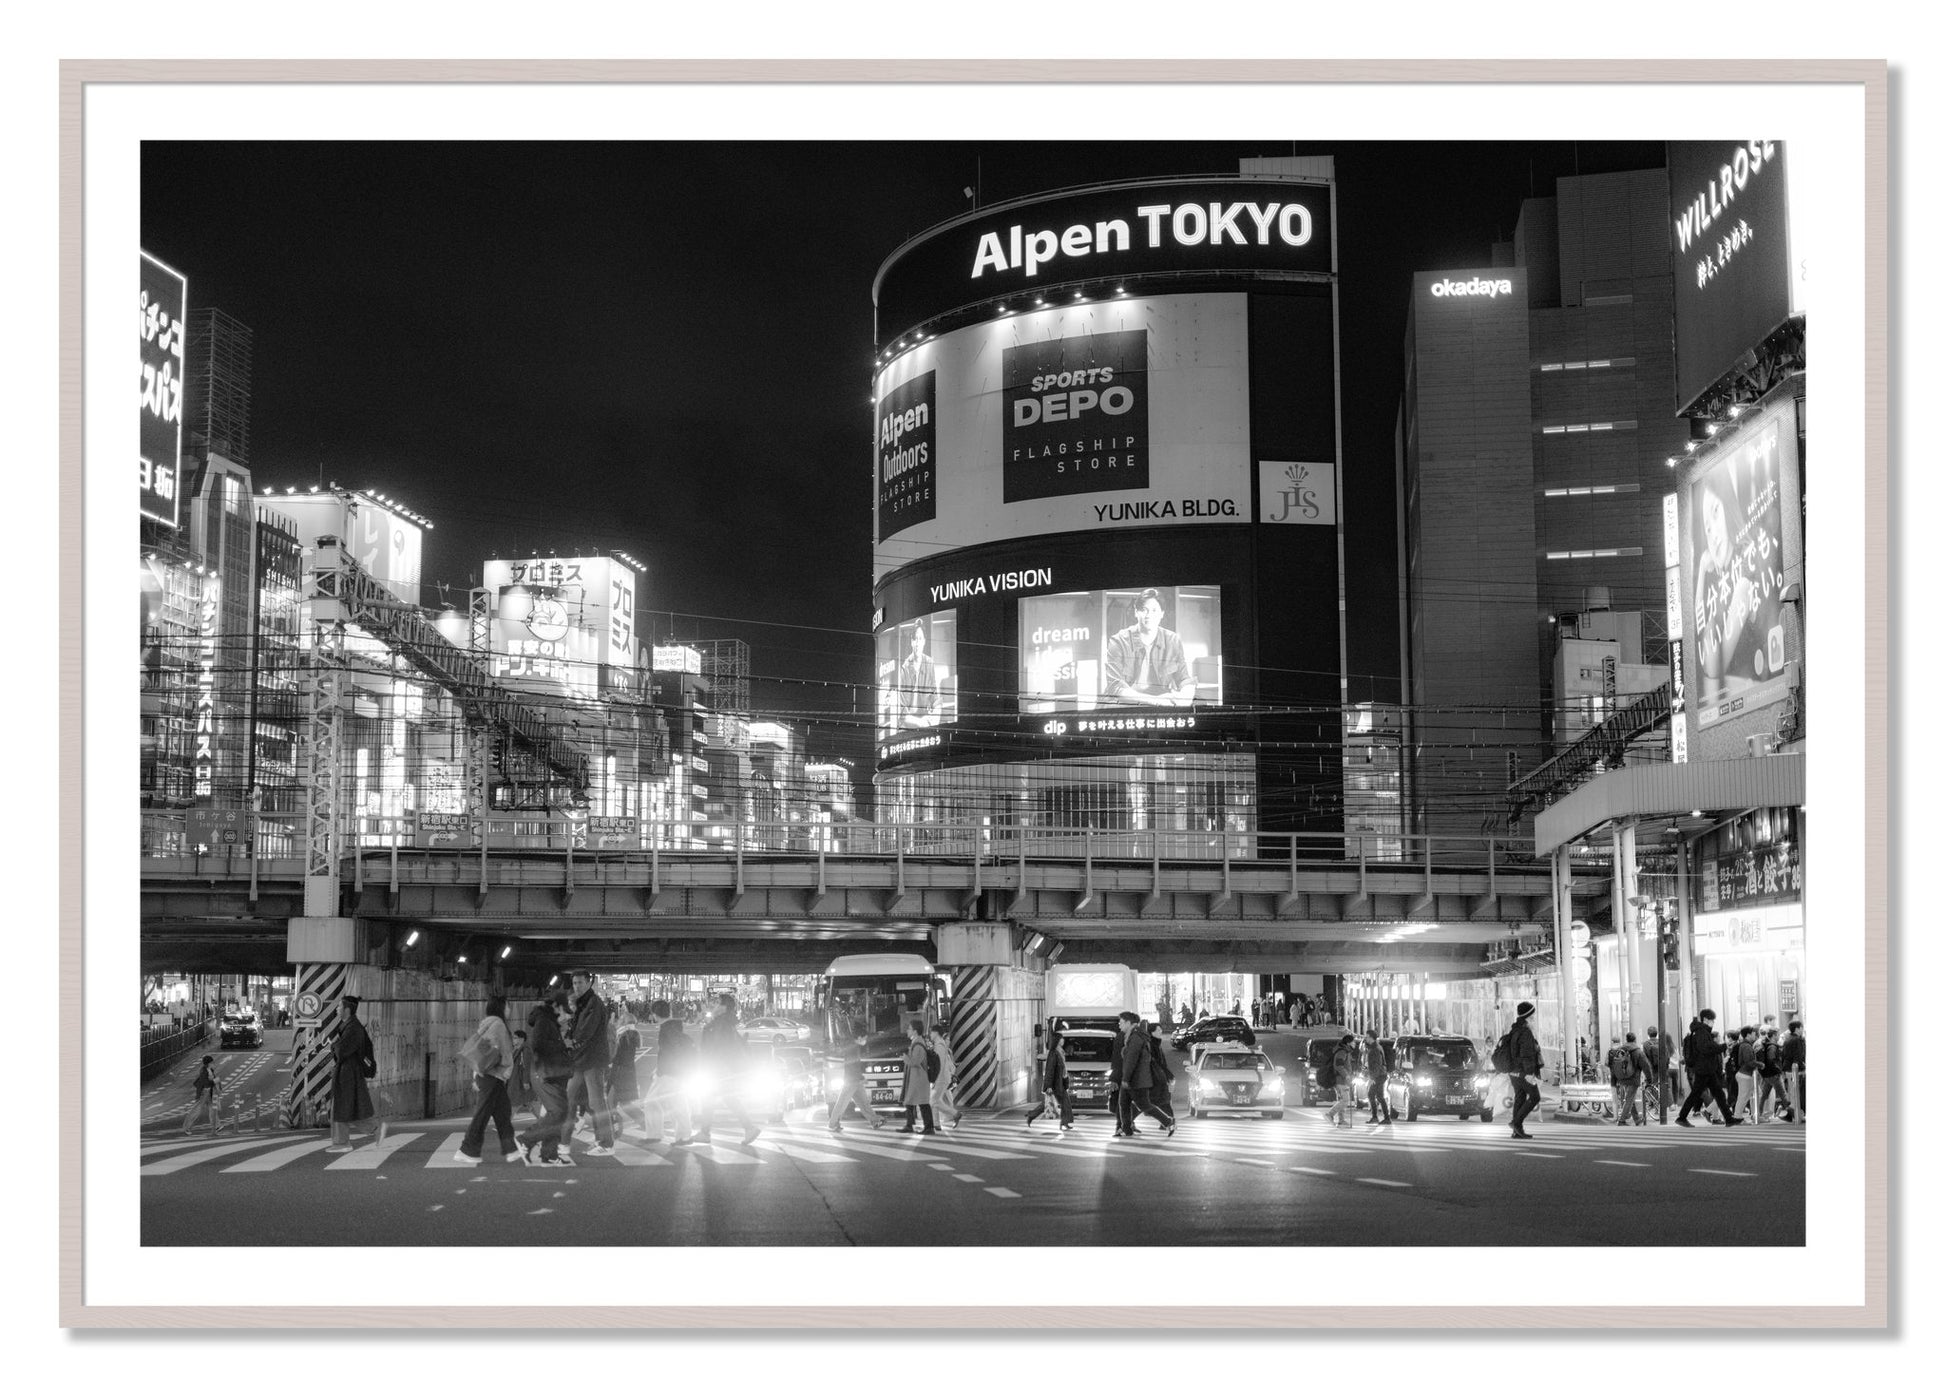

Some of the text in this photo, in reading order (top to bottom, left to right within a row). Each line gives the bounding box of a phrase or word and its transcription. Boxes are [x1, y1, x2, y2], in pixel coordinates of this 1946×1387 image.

[1676, 140, 1774, 253] WILLROSE
[971, 203, 1313, 279] Alpen TOKYO
[1431, 277, 1512, 298] okadaya
[140, 361, 182, 425] スパス
[1031, 366, 1113, 393] SPORTS
[1013, 386, 1134, 428] DEPO
[880, 402, 929, 450] Alpen
[882, 441, 928, 484] Outdoors
[1013, 436, 1136, 463] FLAGSHIP
[1057, 454, 1136, 474] STORE
[880, 471, 929, 505] FLAGSHIP
[893, 488, 929, 513] STORE
[1094, 499, 1240, 523] YUNIKA BLDG.
[266, 568, 296, 590] SHISHA
[510, 562, 583, 584] プロミス
[930, 567, 1052, 604] YUNIKA VISION
[1696, 527, 1778, 635] 自分本位でも、
[1698, 567, 1783, 666] いいじゃない。
[1032, 627, 1090, 644] dream
[1044, 717, 1196, 736] dip 夢を叶える仕事に出会おう
[421, 814, 467, 825] 新宿駅東口
[590, 817, 635, 828] 新宿駅東口
